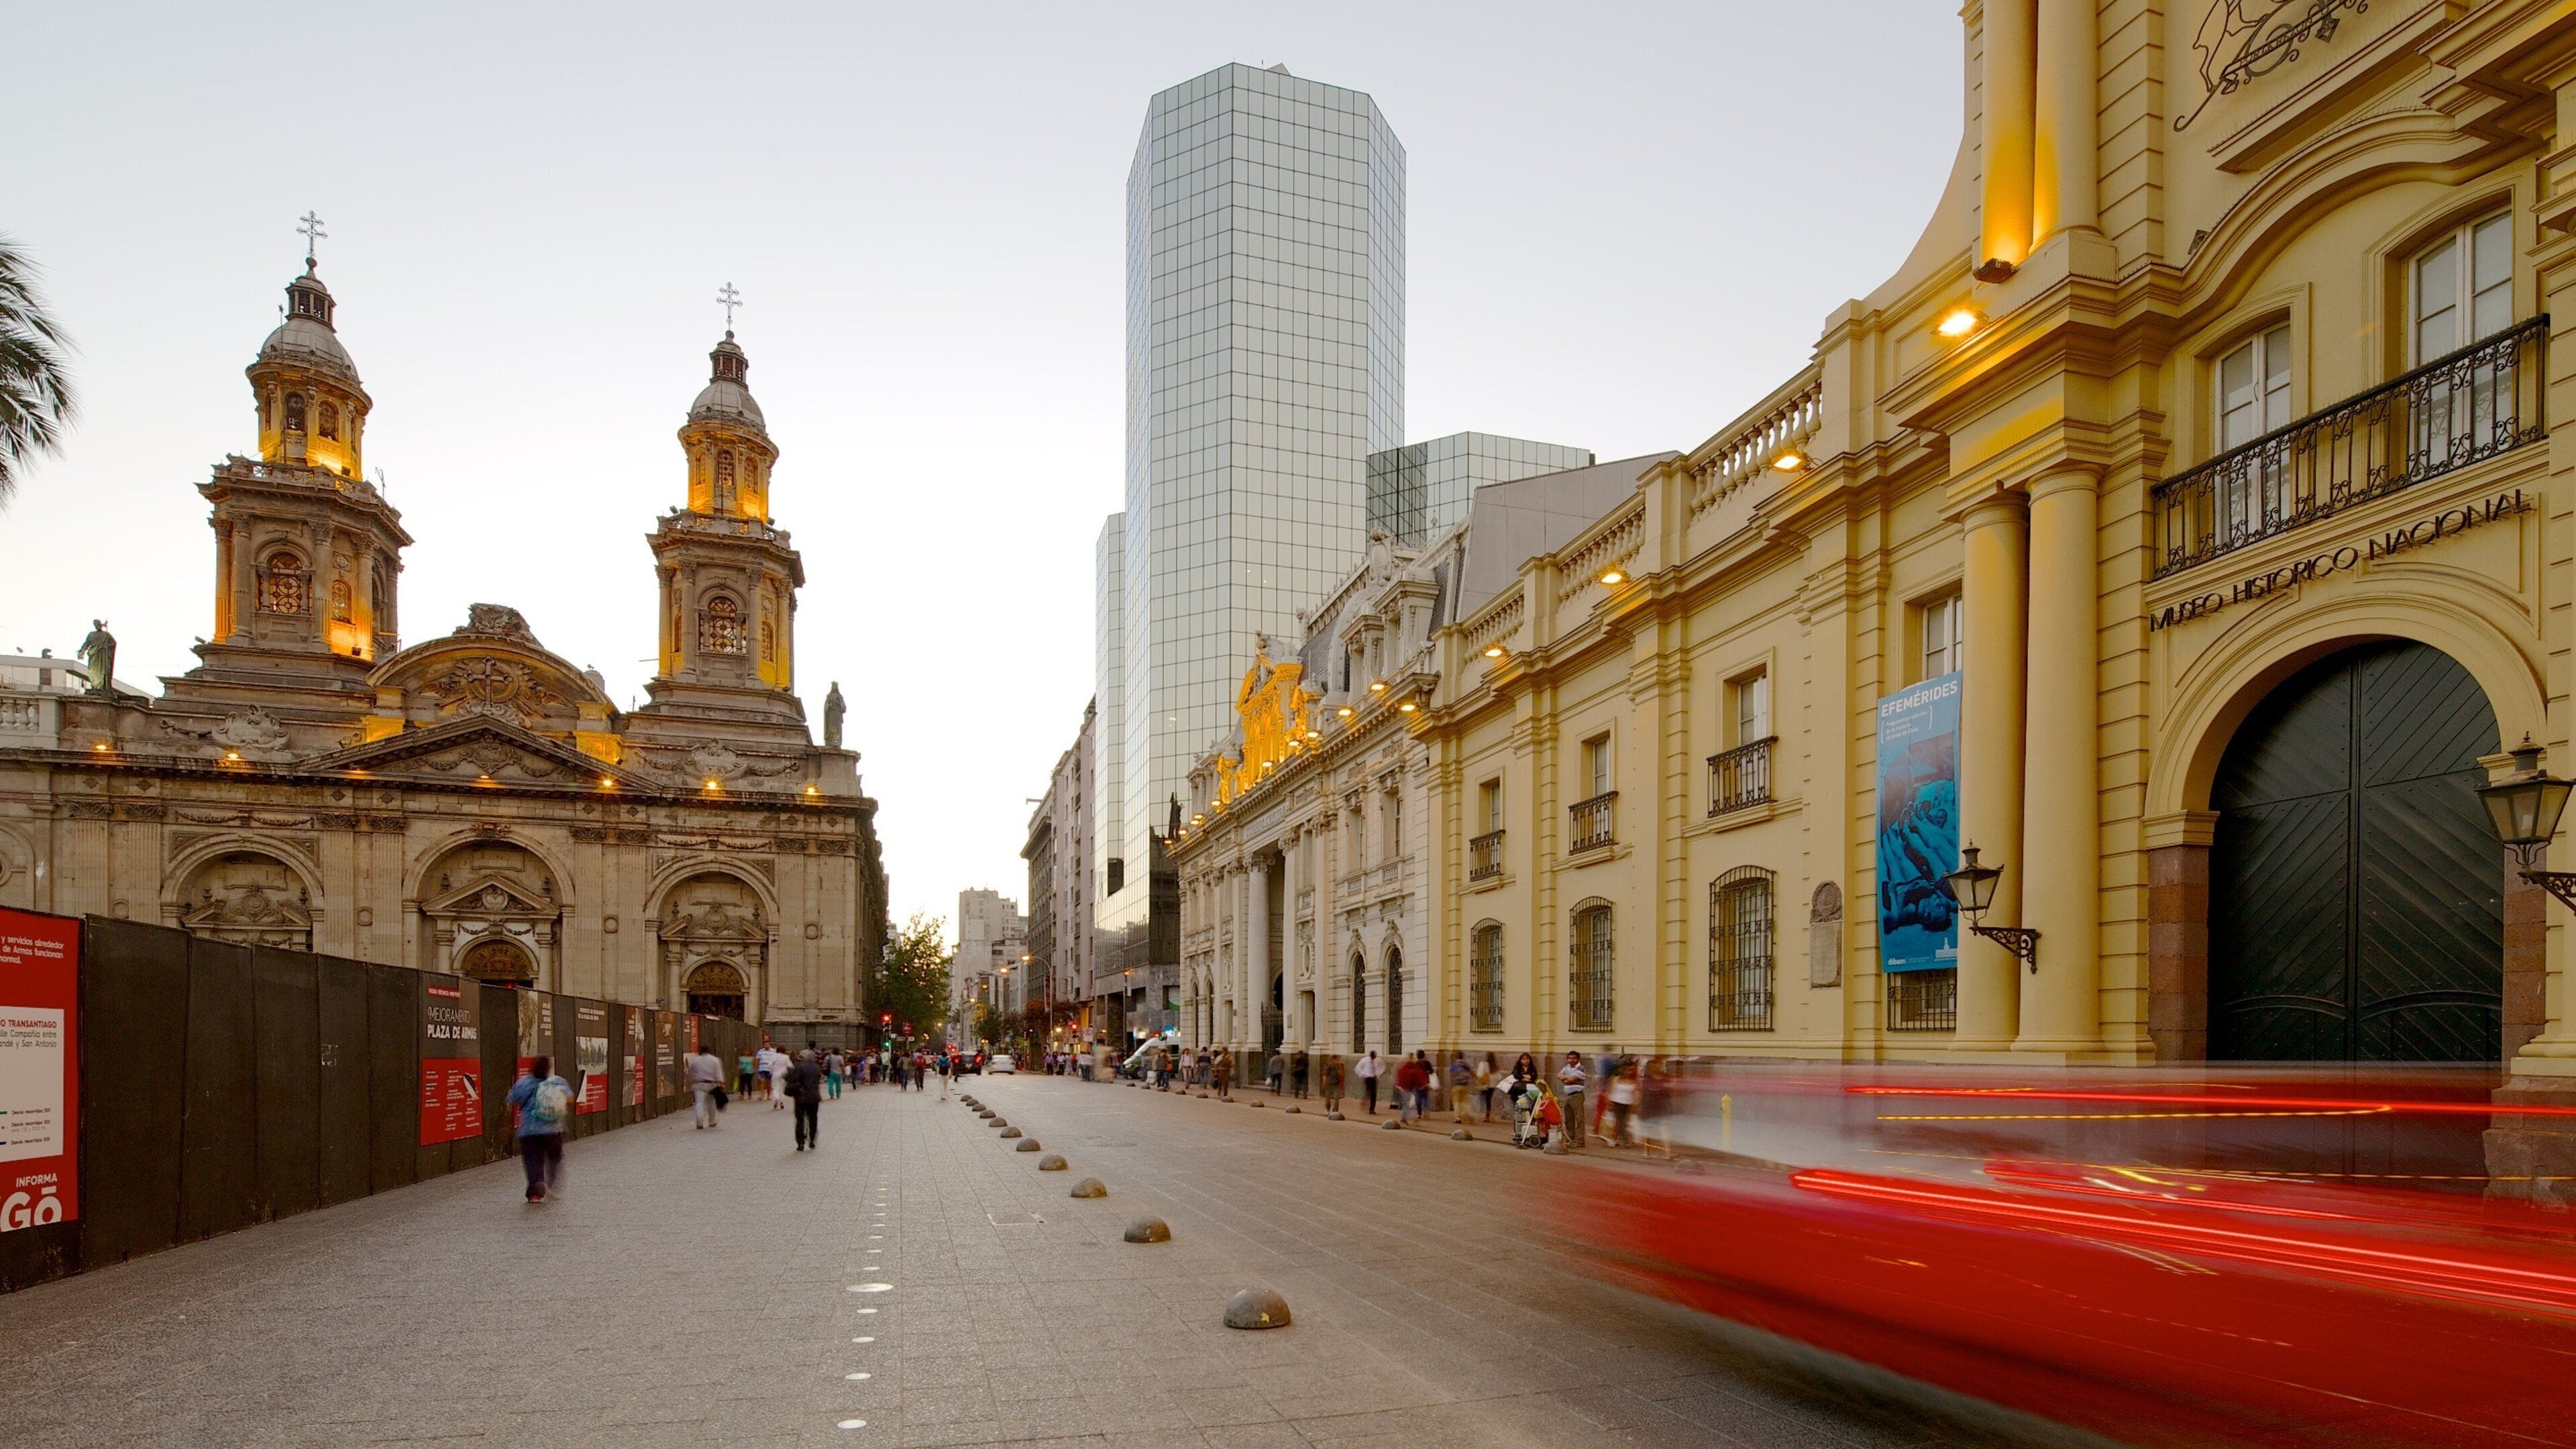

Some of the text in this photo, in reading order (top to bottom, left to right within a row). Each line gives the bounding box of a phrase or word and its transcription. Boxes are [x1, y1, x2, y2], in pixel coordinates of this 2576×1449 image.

[2150, 488, 2532, 632] MUSEO HISTORICO NACIONAL
[1881, 680, 1957, 717] EFEMÉRIDES
[1, 935, 64, 949] y servicios alrededor
[2, 945, 64, 959] de Armas funcionan
[8, 1020, 57, 1028] TRANSANTIAGO
[427, 1024, 477, 1040] PLAZA DE ARMAS
[15, 1041, 19, 1049] y
[35, 1040, 57, 1048] Antonio
[15, 1173, 58, 1188] INFORMA
